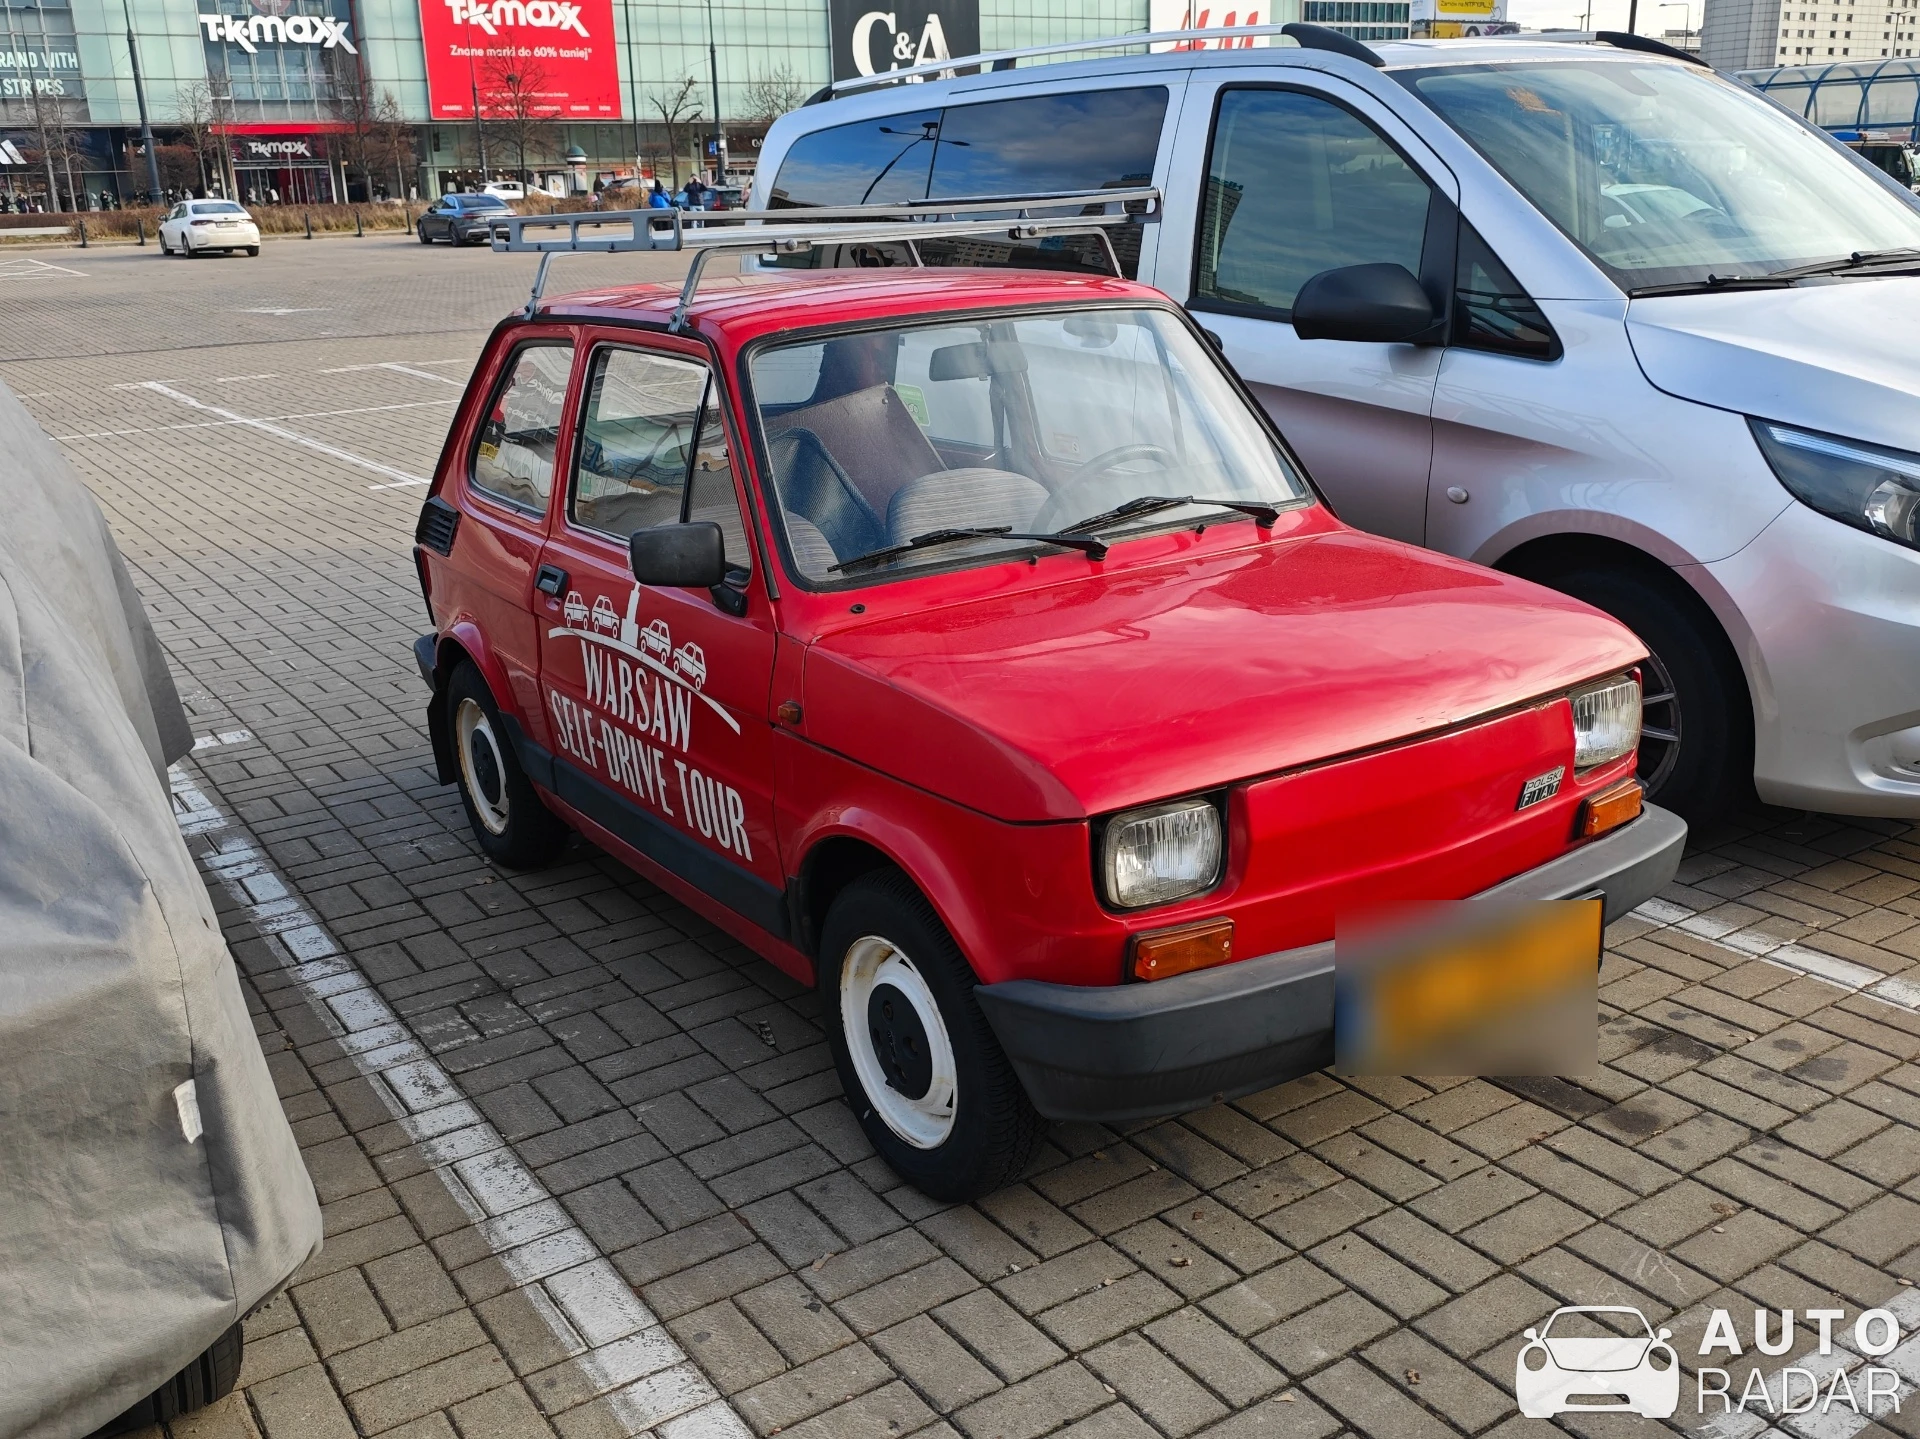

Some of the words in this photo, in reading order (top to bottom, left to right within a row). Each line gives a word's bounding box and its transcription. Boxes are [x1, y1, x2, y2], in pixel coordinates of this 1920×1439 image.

[450, 45, 484, 57] Znane
[486, 46, 516, 57] marki
[518, 46, 532, 57] do
[533, 46, 557, 58] 60%
[852, 11, 957, 84] C&A
[40, 52, 79, 68] WITH
[3, 79, 64, 95] STRPES
[580, 639, 692, 753] WARSAW
[551, 690, 674, 818] SELF-DRIVE
[674, 759, 753, 862] TOUR
[1526, 769, 1563, 792] POLSKI
[1521, 781, 1560, 807] FIAT
